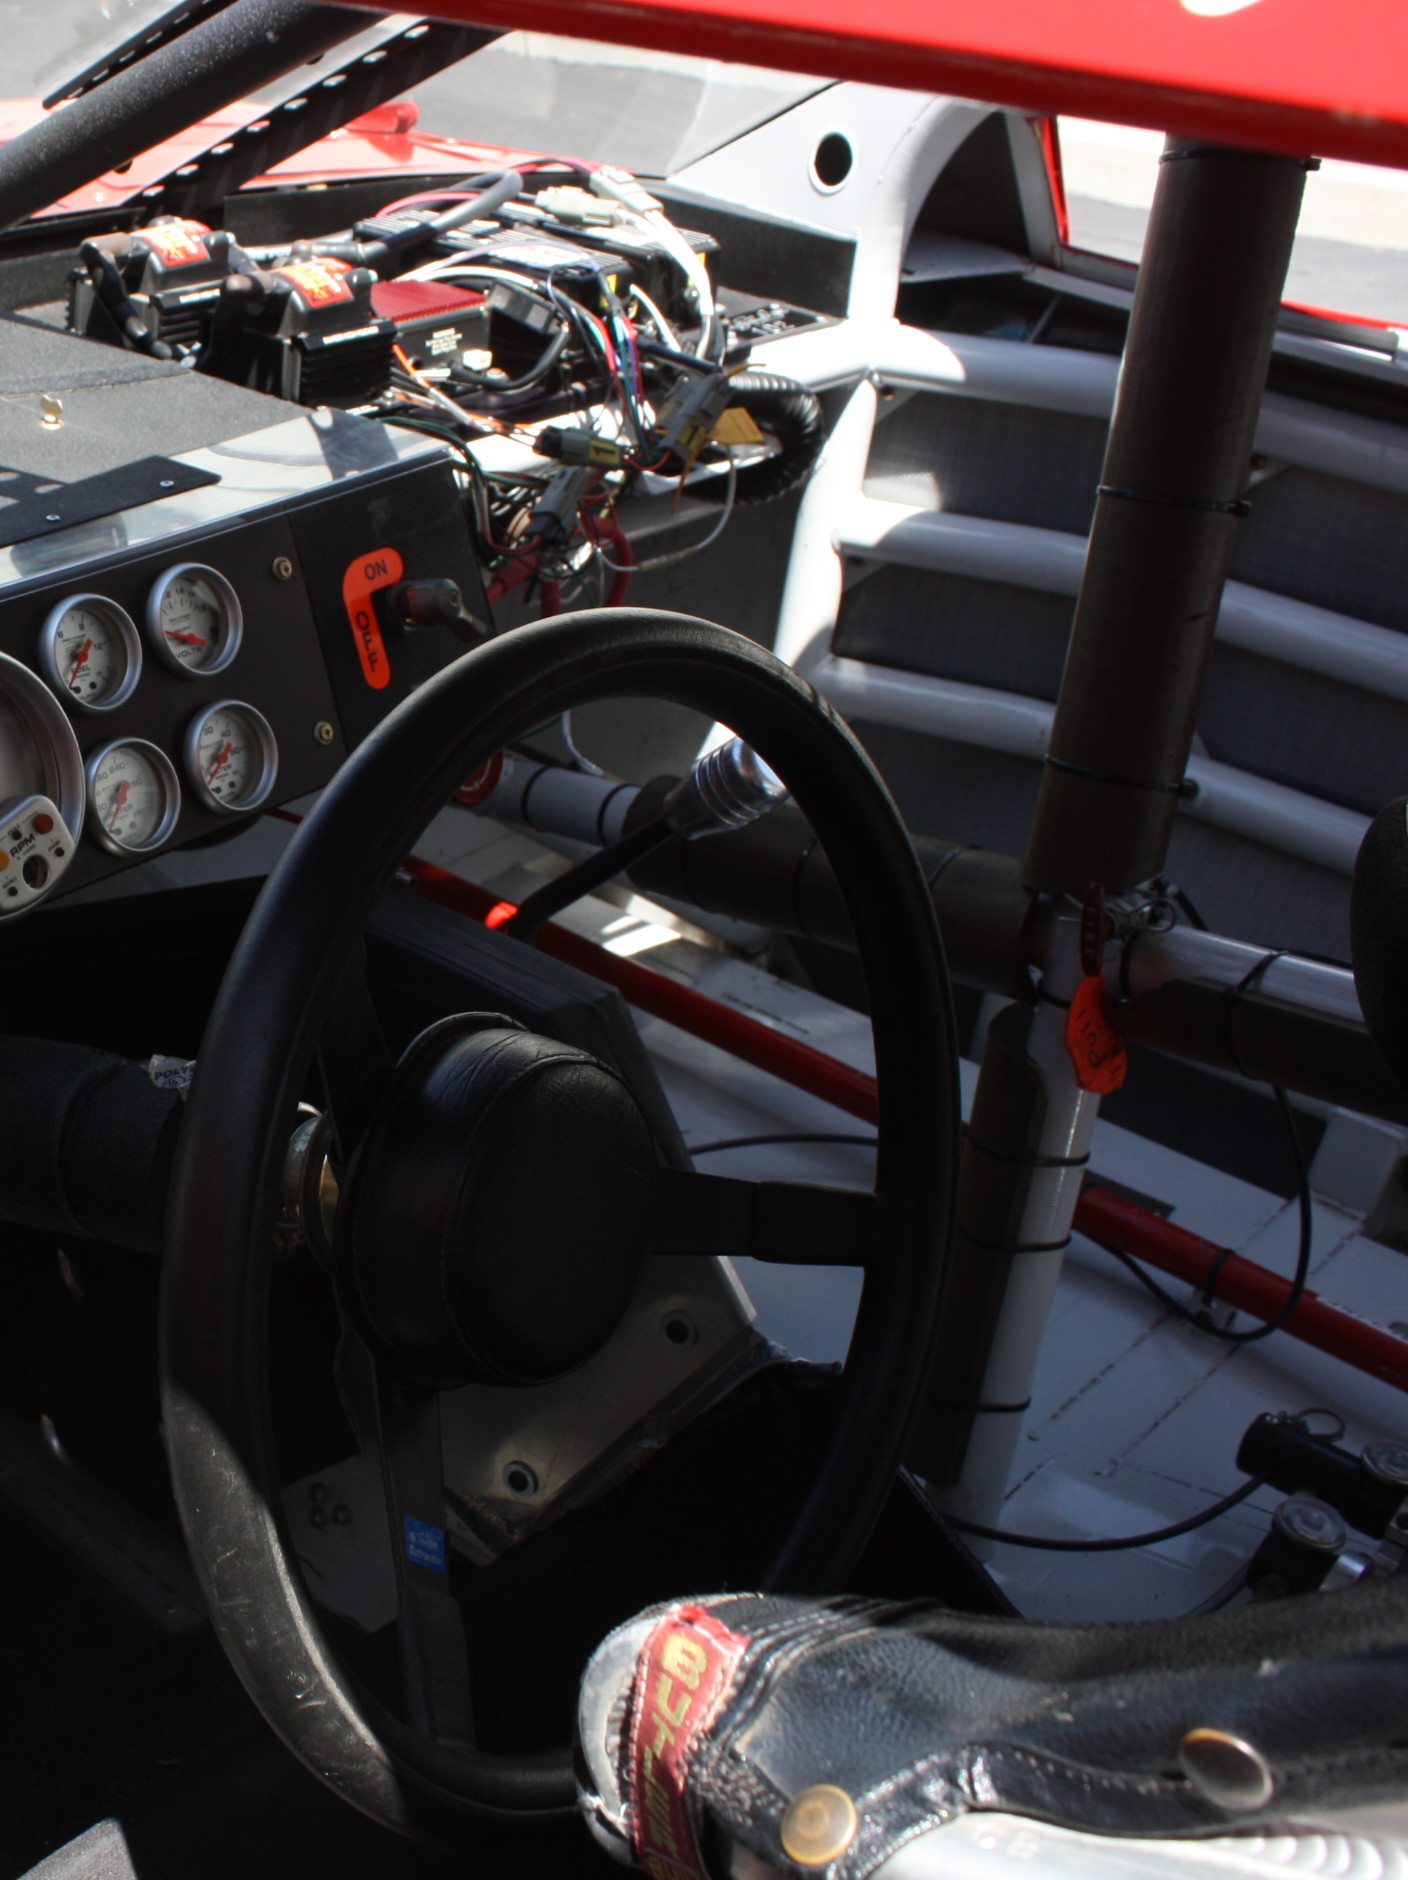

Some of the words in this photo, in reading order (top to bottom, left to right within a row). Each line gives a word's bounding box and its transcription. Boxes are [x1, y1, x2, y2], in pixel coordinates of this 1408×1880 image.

[364, 559, 388, 580] ON
[356, 611, 379, 672] OFF
[9, 832, 36, 858] RPM
